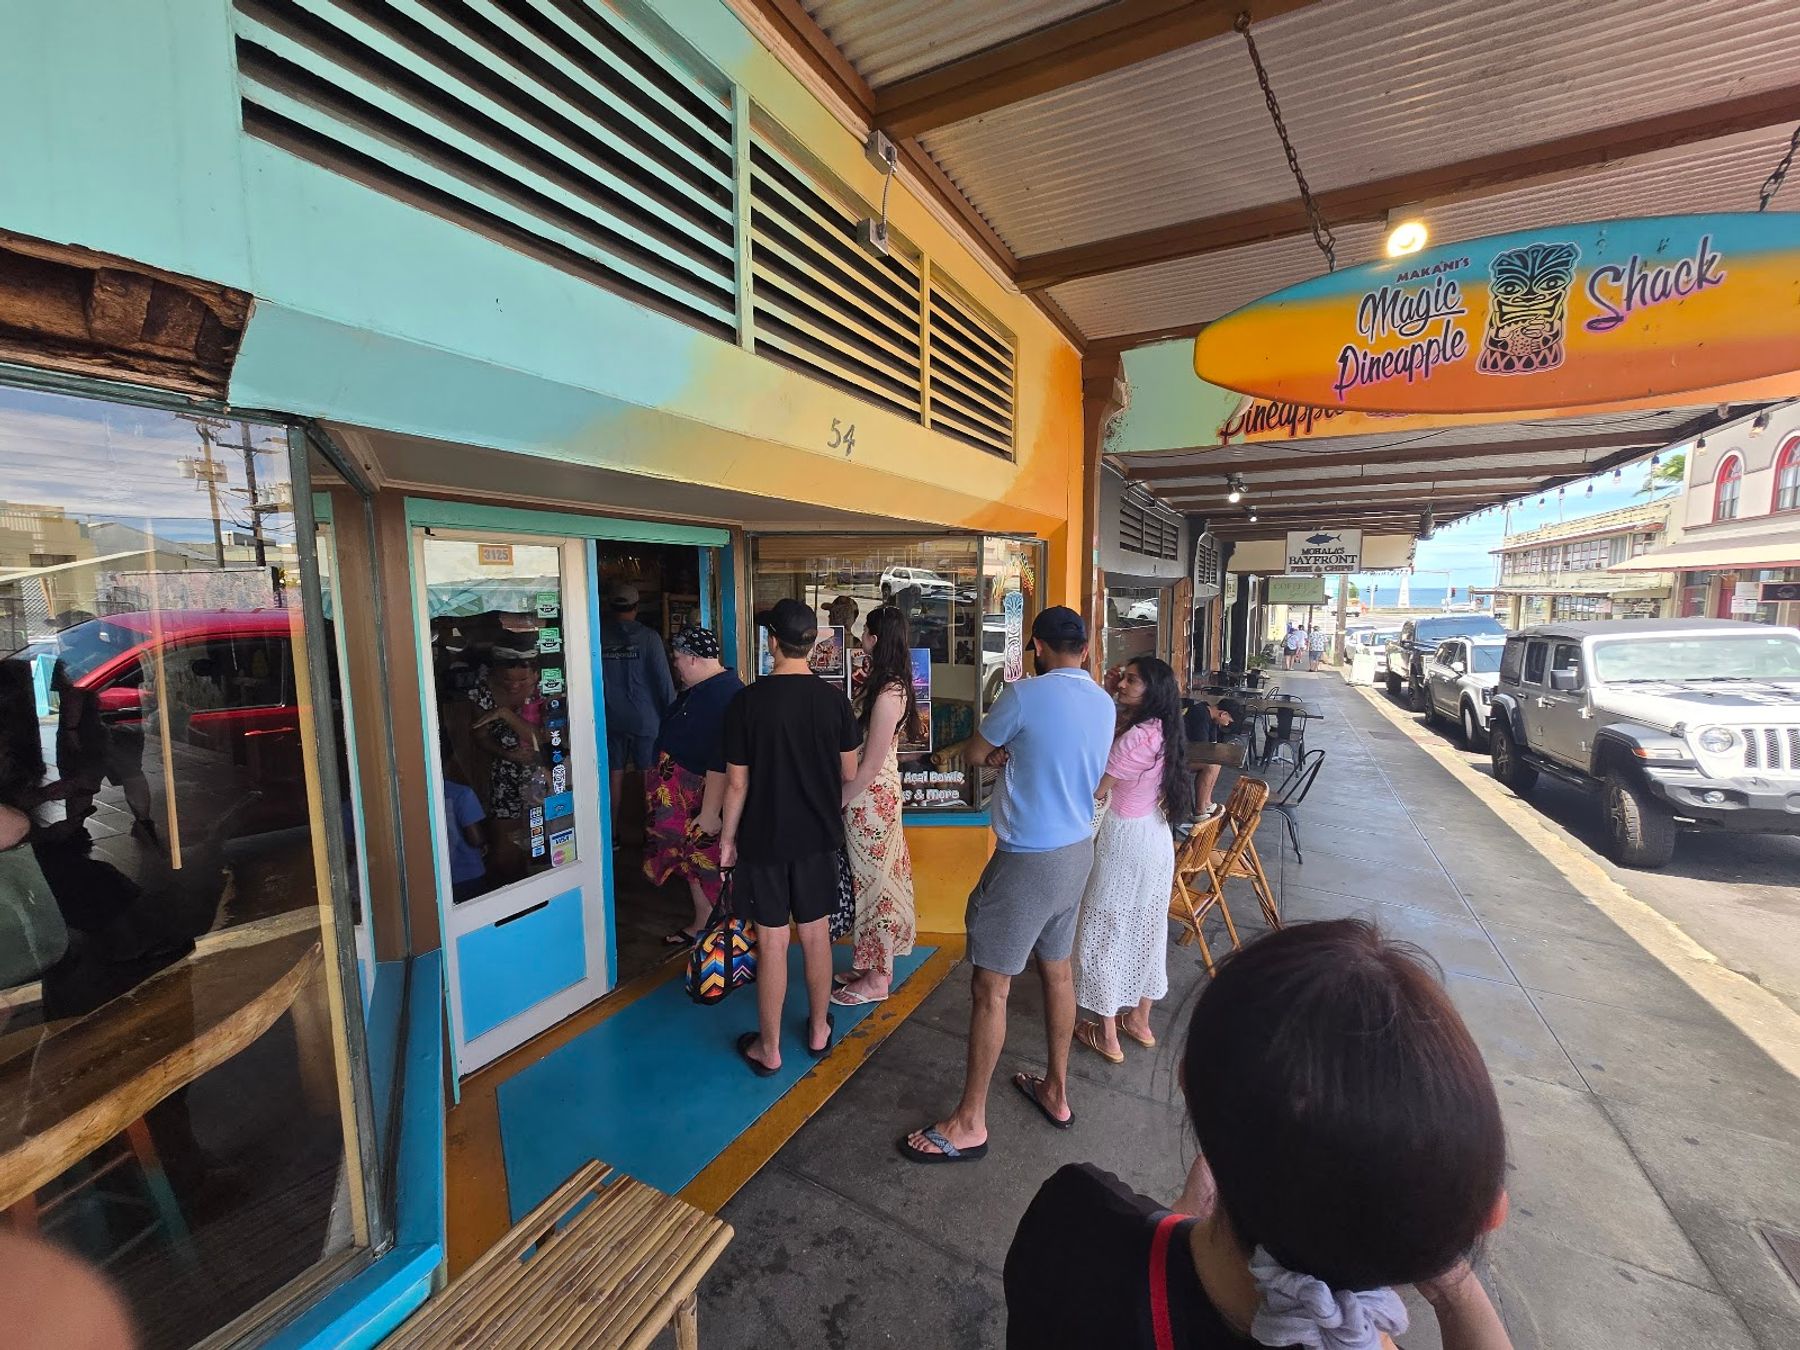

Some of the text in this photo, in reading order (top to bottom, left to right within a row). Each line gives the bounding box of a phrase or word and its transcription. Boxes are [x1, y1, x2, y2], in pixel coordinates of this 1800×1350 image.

[1396, 257, 1470, 283] MAKANI'S
[1586, 235, 1724, 331] Shack
[1358, 276, 1466, 342] Magic
[1334, 319, 1467, 401] Pineapple
[827, 417, 856, 457] 54
[484, 548, 509, 561] 3125
[1289, 555, 1358, 565] BAYFRONT
